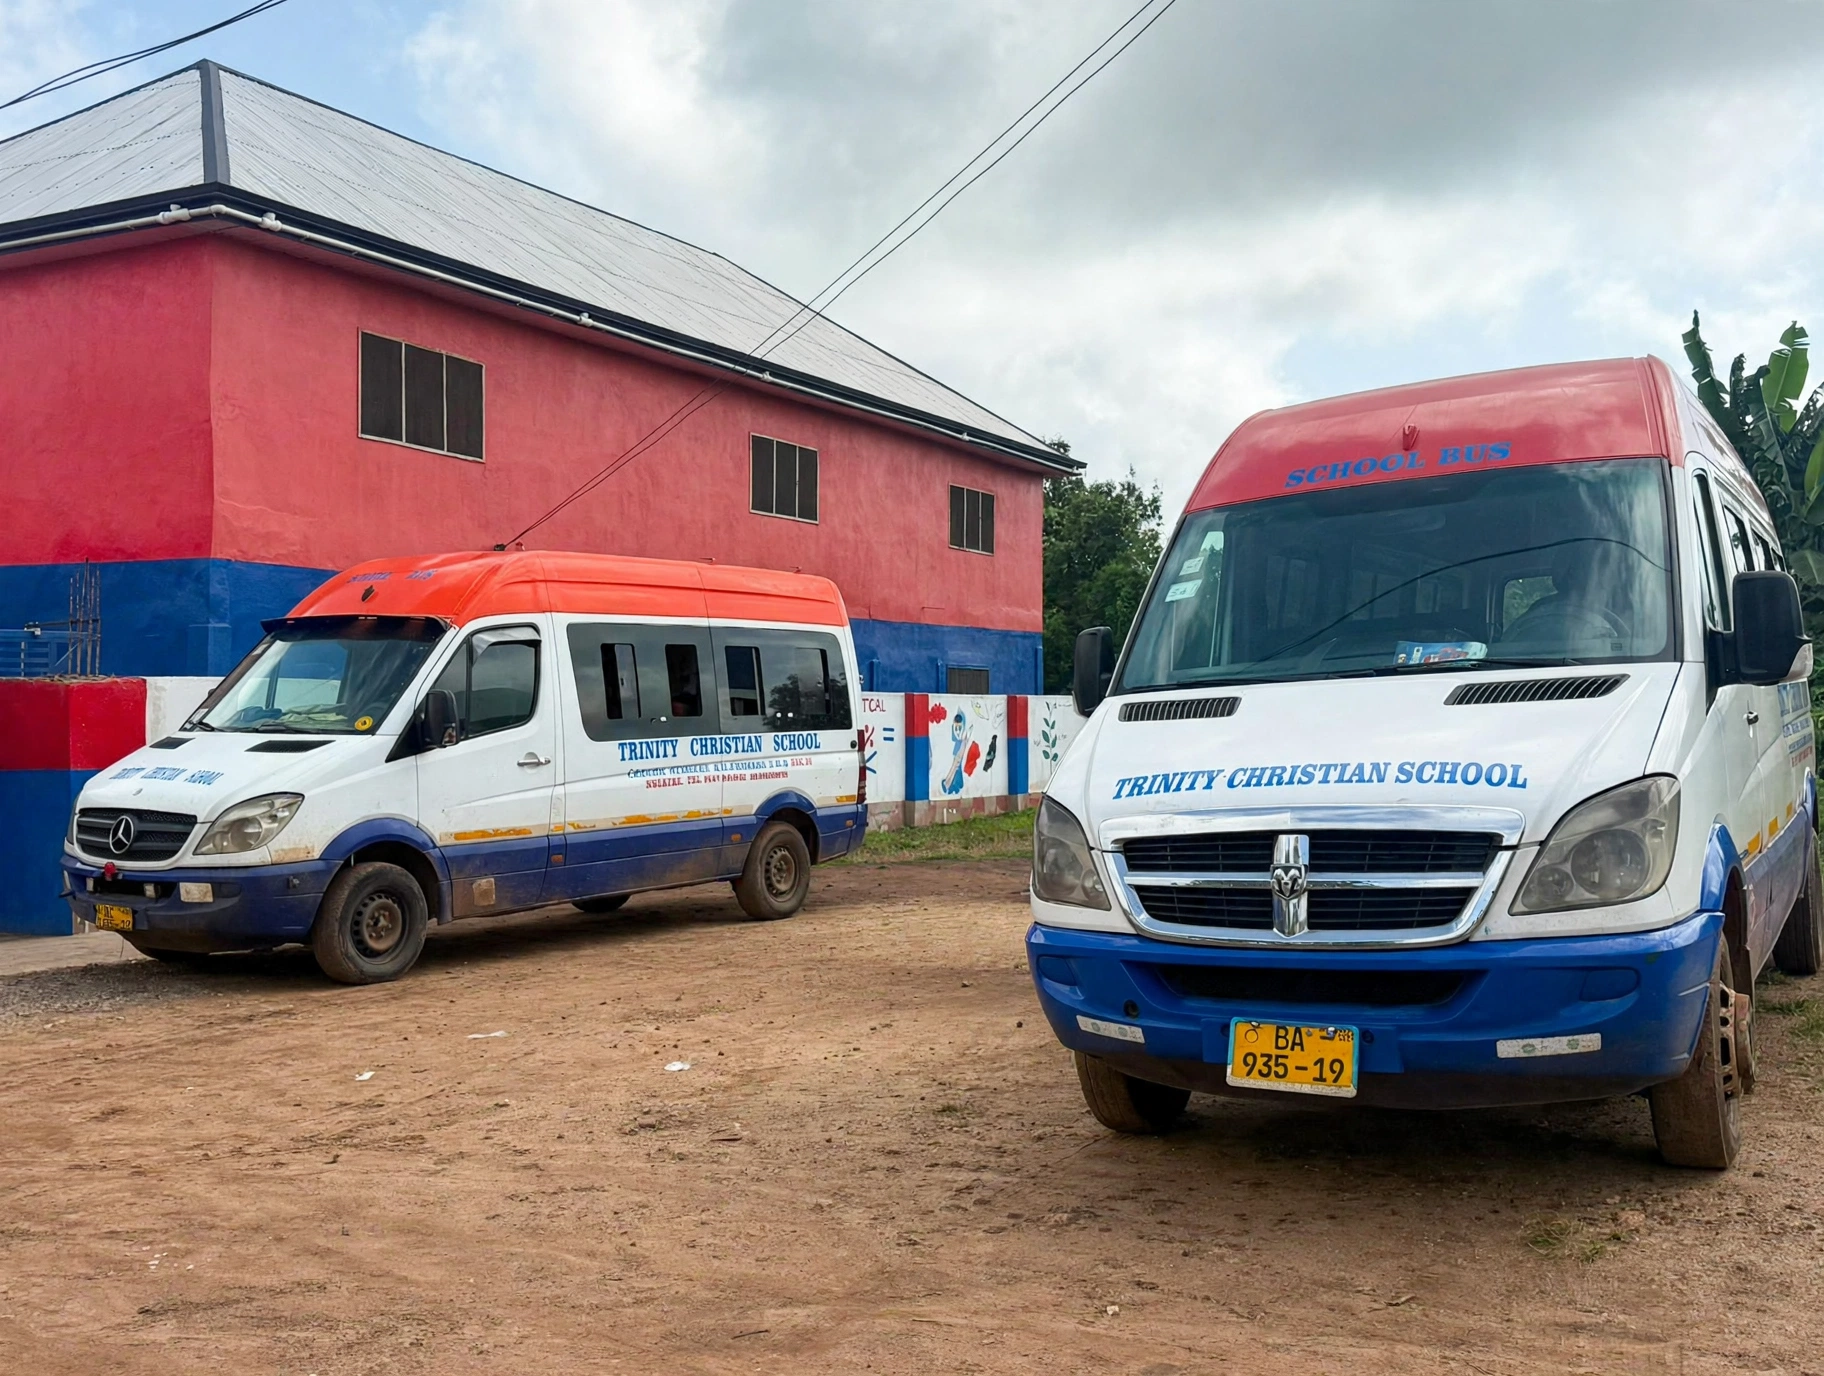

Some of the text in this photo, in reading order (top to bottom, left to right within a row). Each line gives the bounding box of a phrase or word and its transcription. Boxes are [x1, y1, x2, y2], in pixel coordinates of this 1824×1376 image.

[1284, 441, 1512, 489] SCHOOL BUS
[618, 732, 821, 762] TRINITY CHRISTIAN SCHOOL
[1112, 761, 1528, 800] TRINITY CHRISTIAN SCHOOL
[1274, 1025, 1305, 1052] BA
[1242, 1052, 1345, 1084] 935-19
